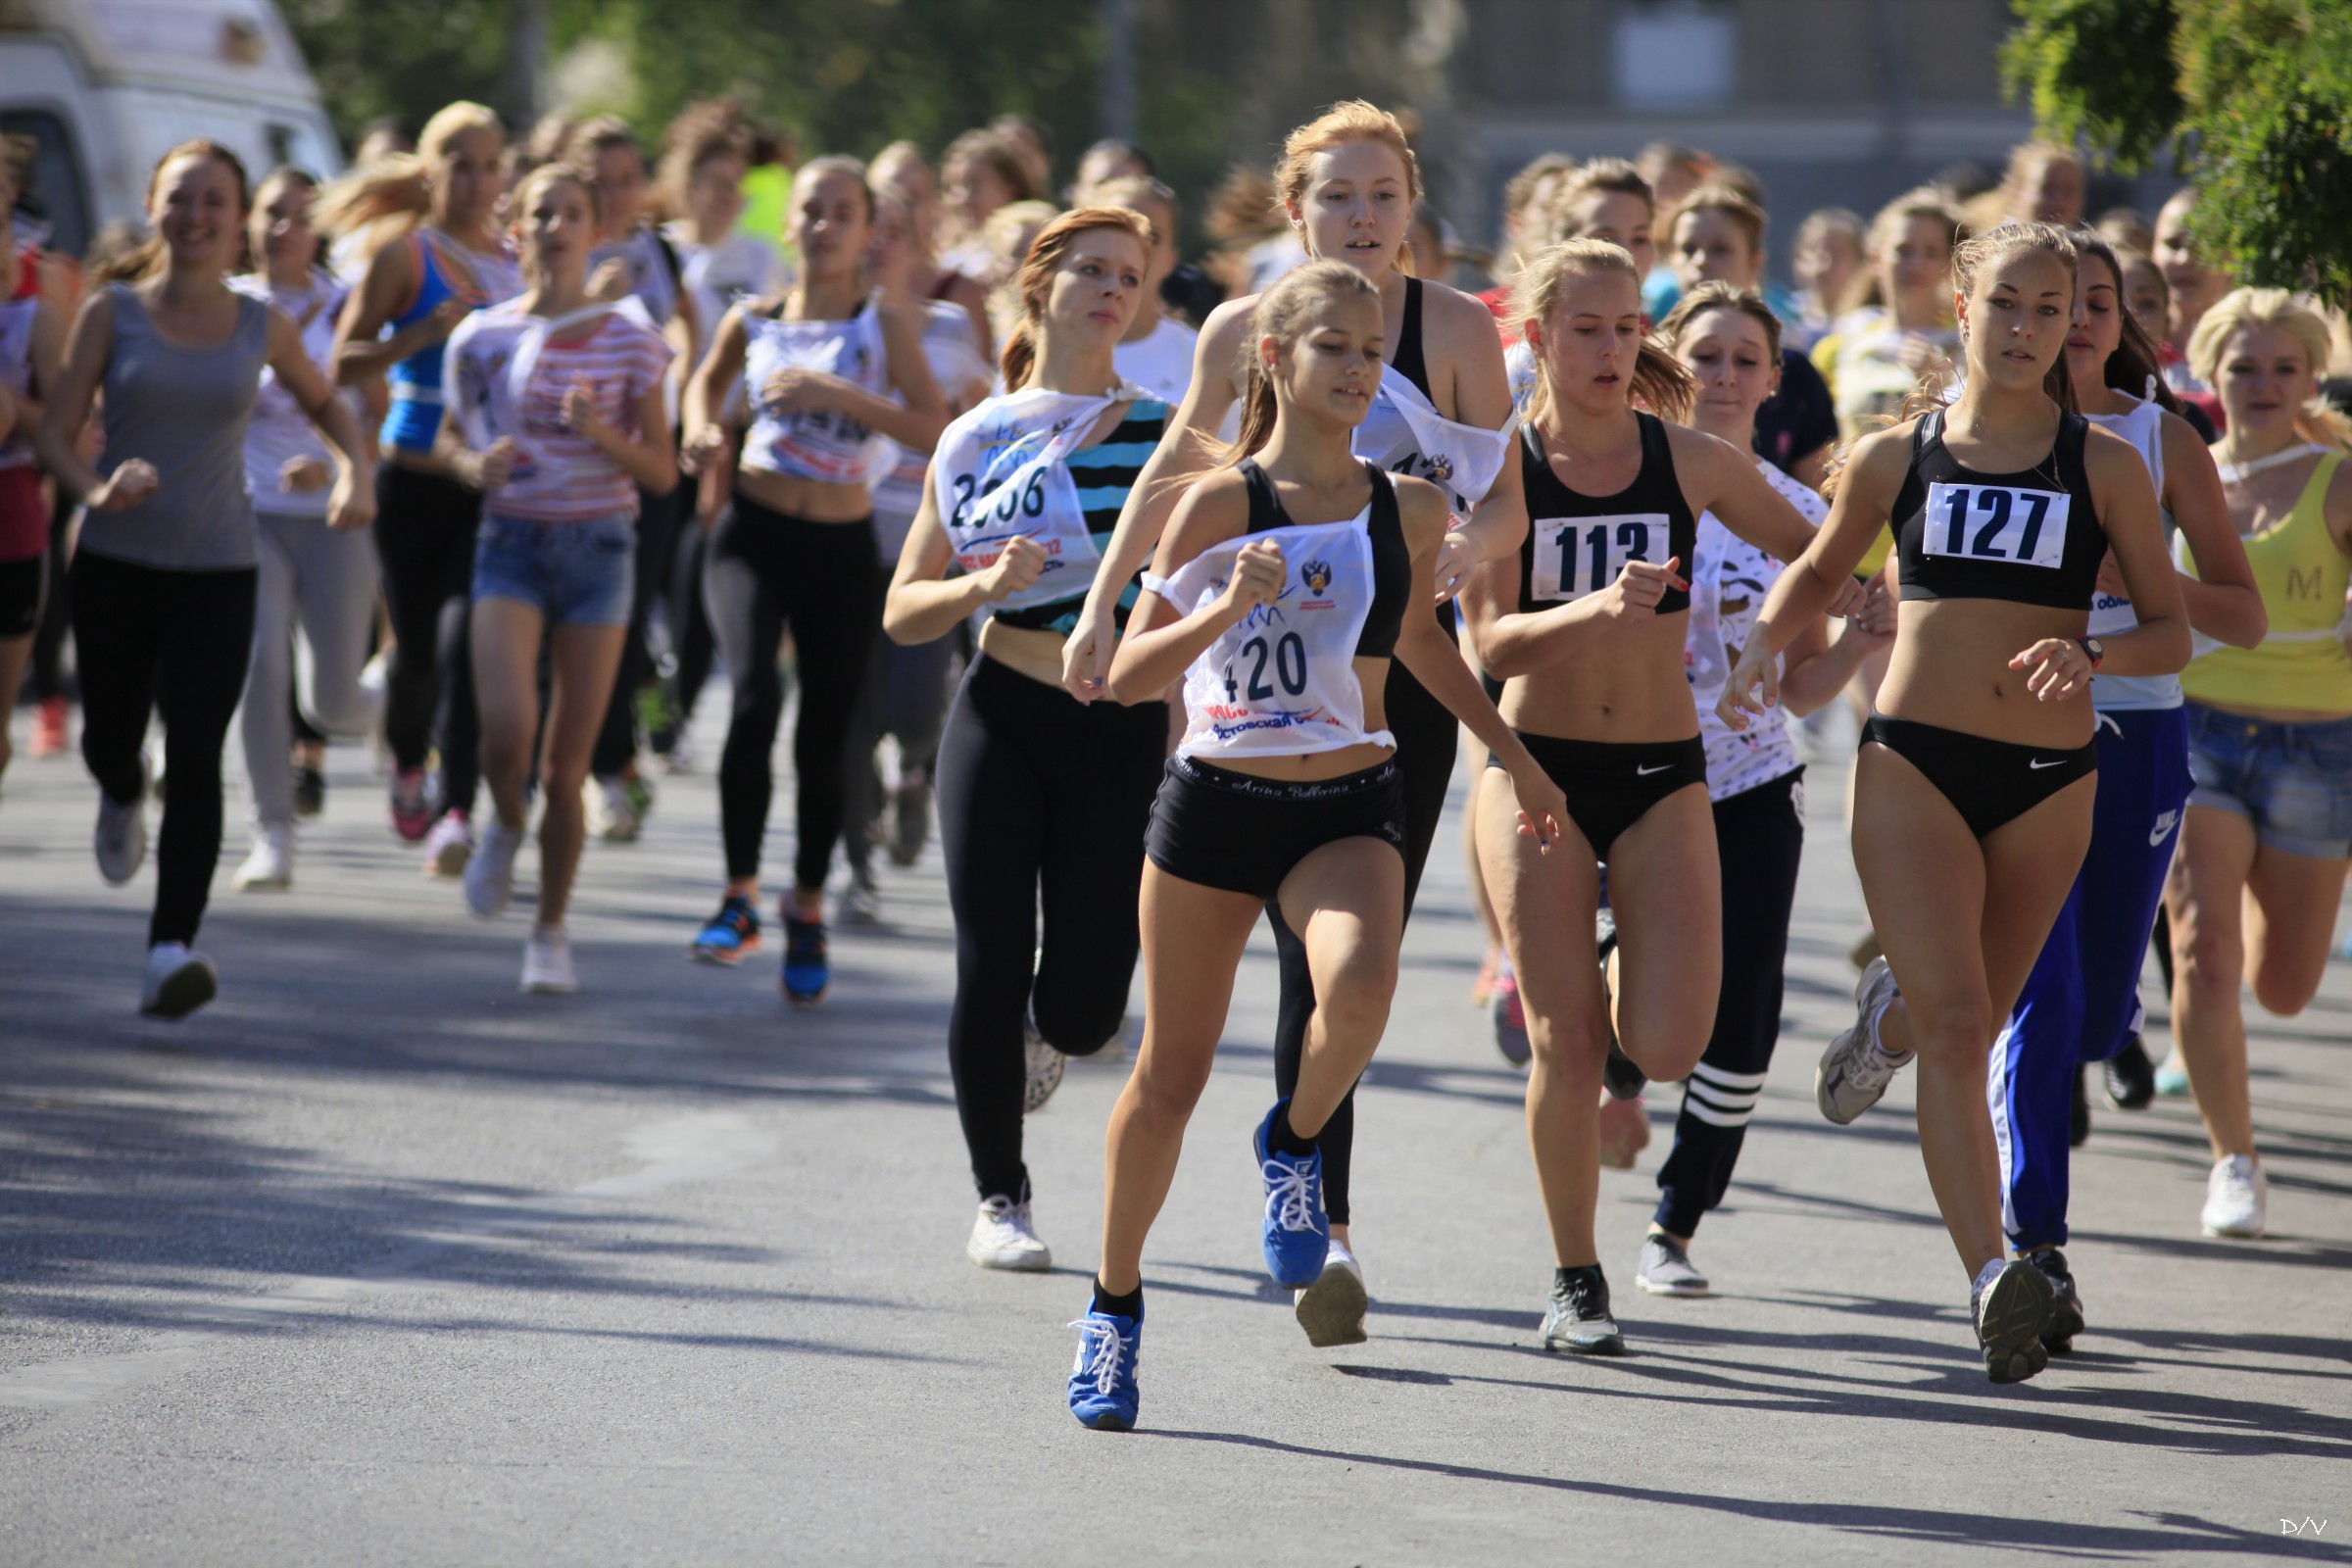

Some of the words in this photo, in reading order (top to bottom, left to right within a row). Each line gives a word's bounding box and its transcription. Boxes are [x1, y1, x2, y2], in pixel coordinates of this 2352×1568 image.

[1555, 521, 1649, 593] 113
[1944, 489, 2051, 561] 127
[2286, 565, 2323, 602] M
[1225, 631, 1307, 704] 420
